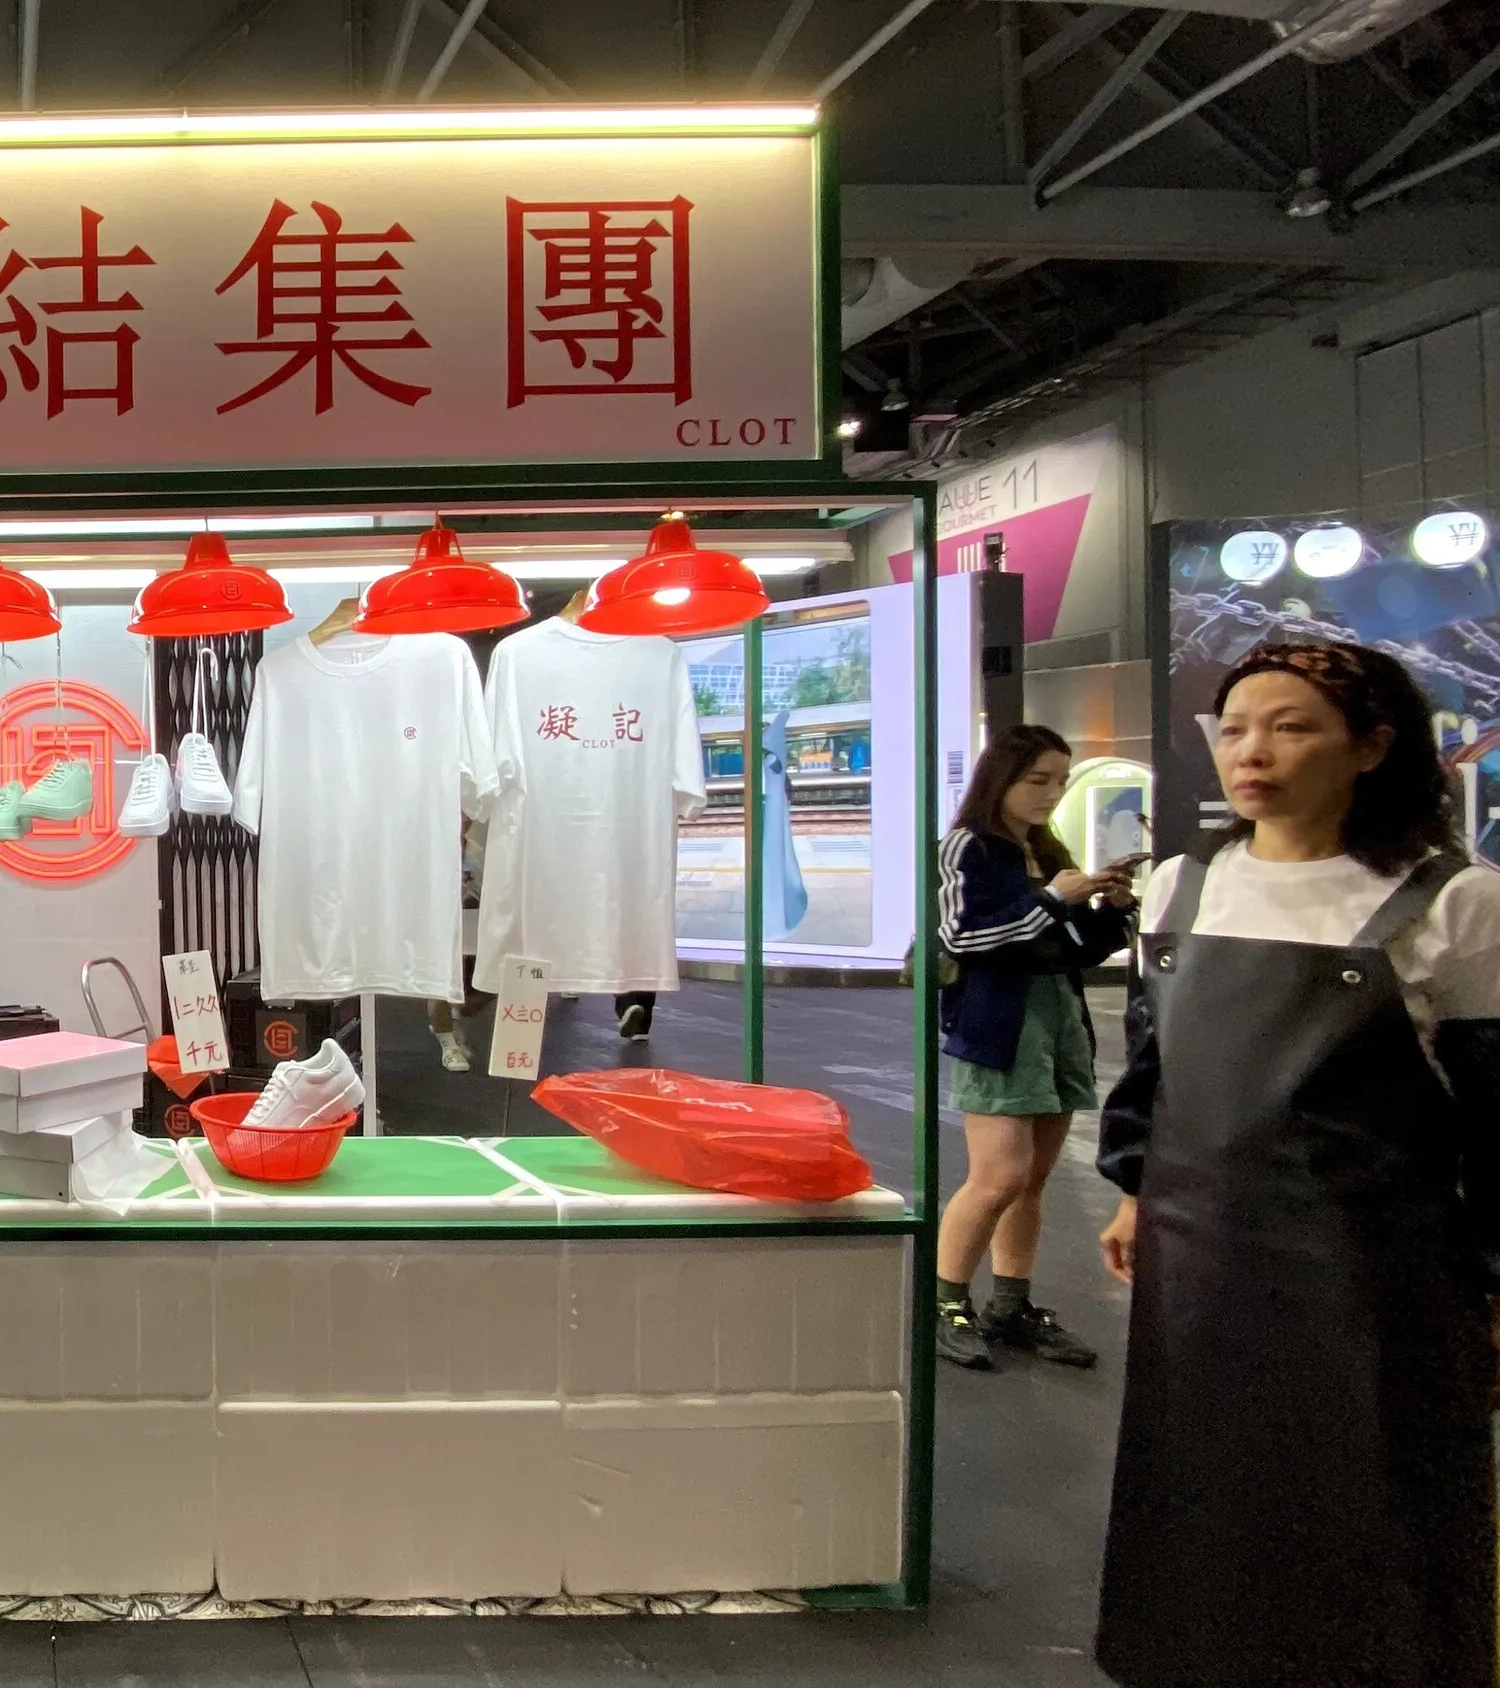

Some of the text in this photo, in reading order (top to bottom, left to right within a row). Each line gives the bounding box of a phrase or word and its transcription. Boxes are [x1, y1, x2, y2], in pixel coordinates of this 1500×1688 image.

[676, 418, 797, 447] CLOT
[1002, 459, 1039, 511] 11
[186, 1041, 223, 1066] 千元
